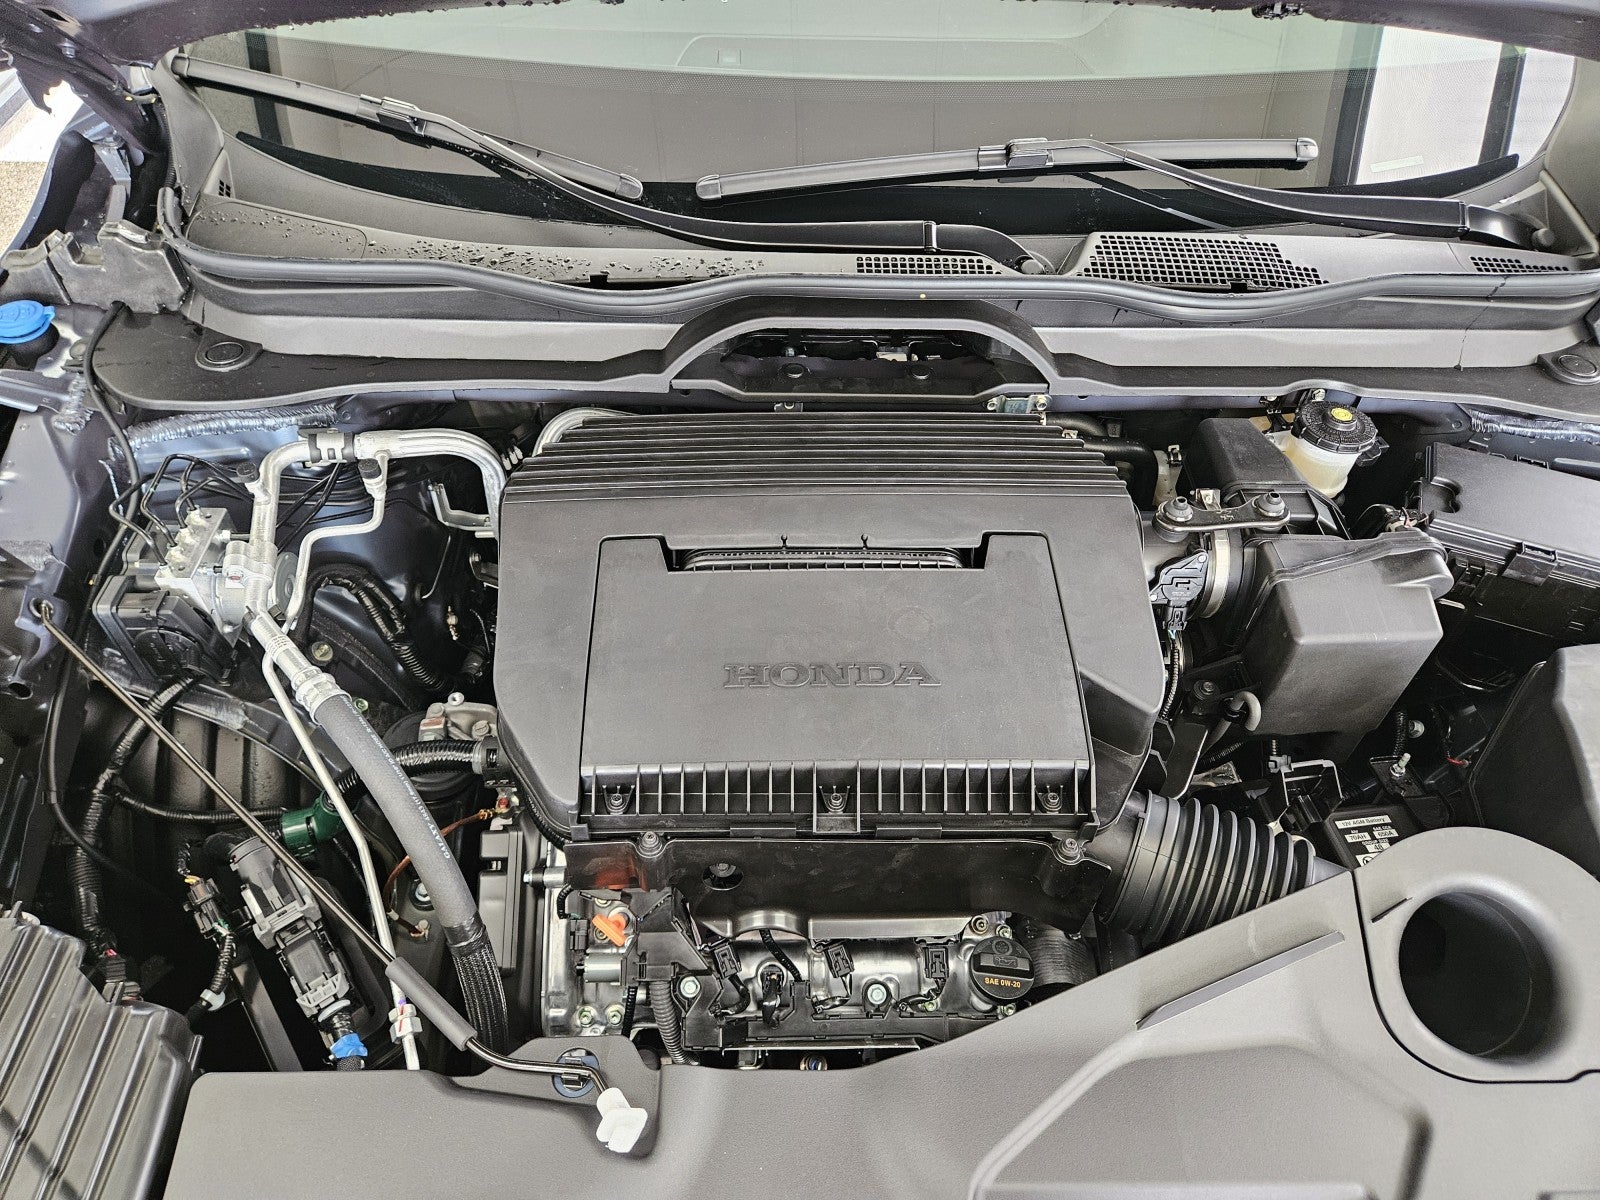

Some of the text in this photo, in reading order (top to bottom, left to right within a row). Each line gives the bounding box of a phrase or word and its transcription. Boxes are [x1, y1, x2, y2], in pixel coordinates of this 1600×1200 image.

[723, 662, 942, 688] HONDA
[428, 822, 451, 859] GALAXY
[984, 977, 1021, 988] SAE 0W-20
